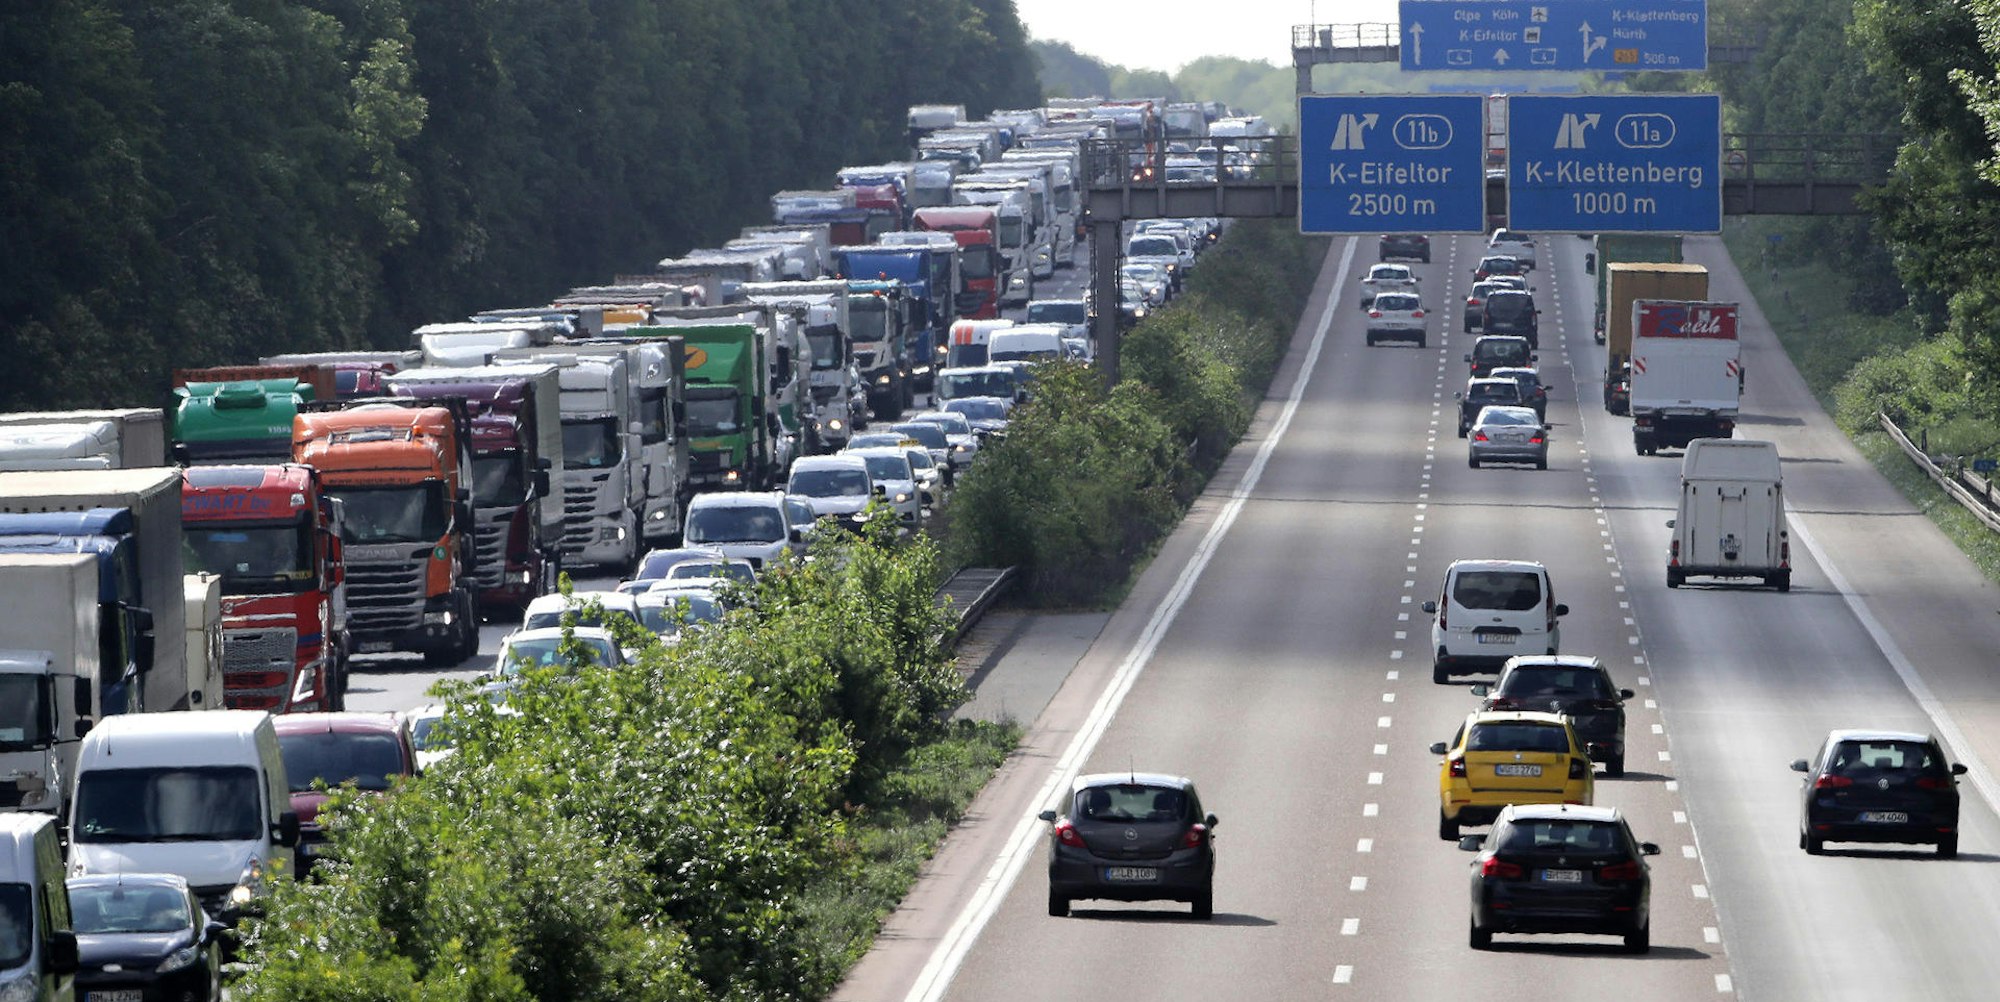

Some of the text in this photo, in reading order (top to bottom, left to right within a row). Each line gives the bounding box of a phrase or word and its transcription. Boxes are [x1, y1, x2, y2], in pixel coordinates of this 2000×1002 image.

[1454, 9, 1519, 23] Olpe Köln
[1612, 9, 1699, 23] K-Klettenberg
[1460, 29, 1518, 41] K-Eifeltor
[1613, 27, 1647, 39] Hürth
[1643, 52, 1680, 65] 500 m
[1408, 120, 1438, 143] 11b
[1630, 120, 1660, 142] 11a
[1330, 162, 1452, 185] K-Eifeltor
[1526, 161, 1703, 189] K-Klettenberg
[1349, 193, 1435, 216] 2500 m
[1573, 192, 1656, 214] 1000 m
